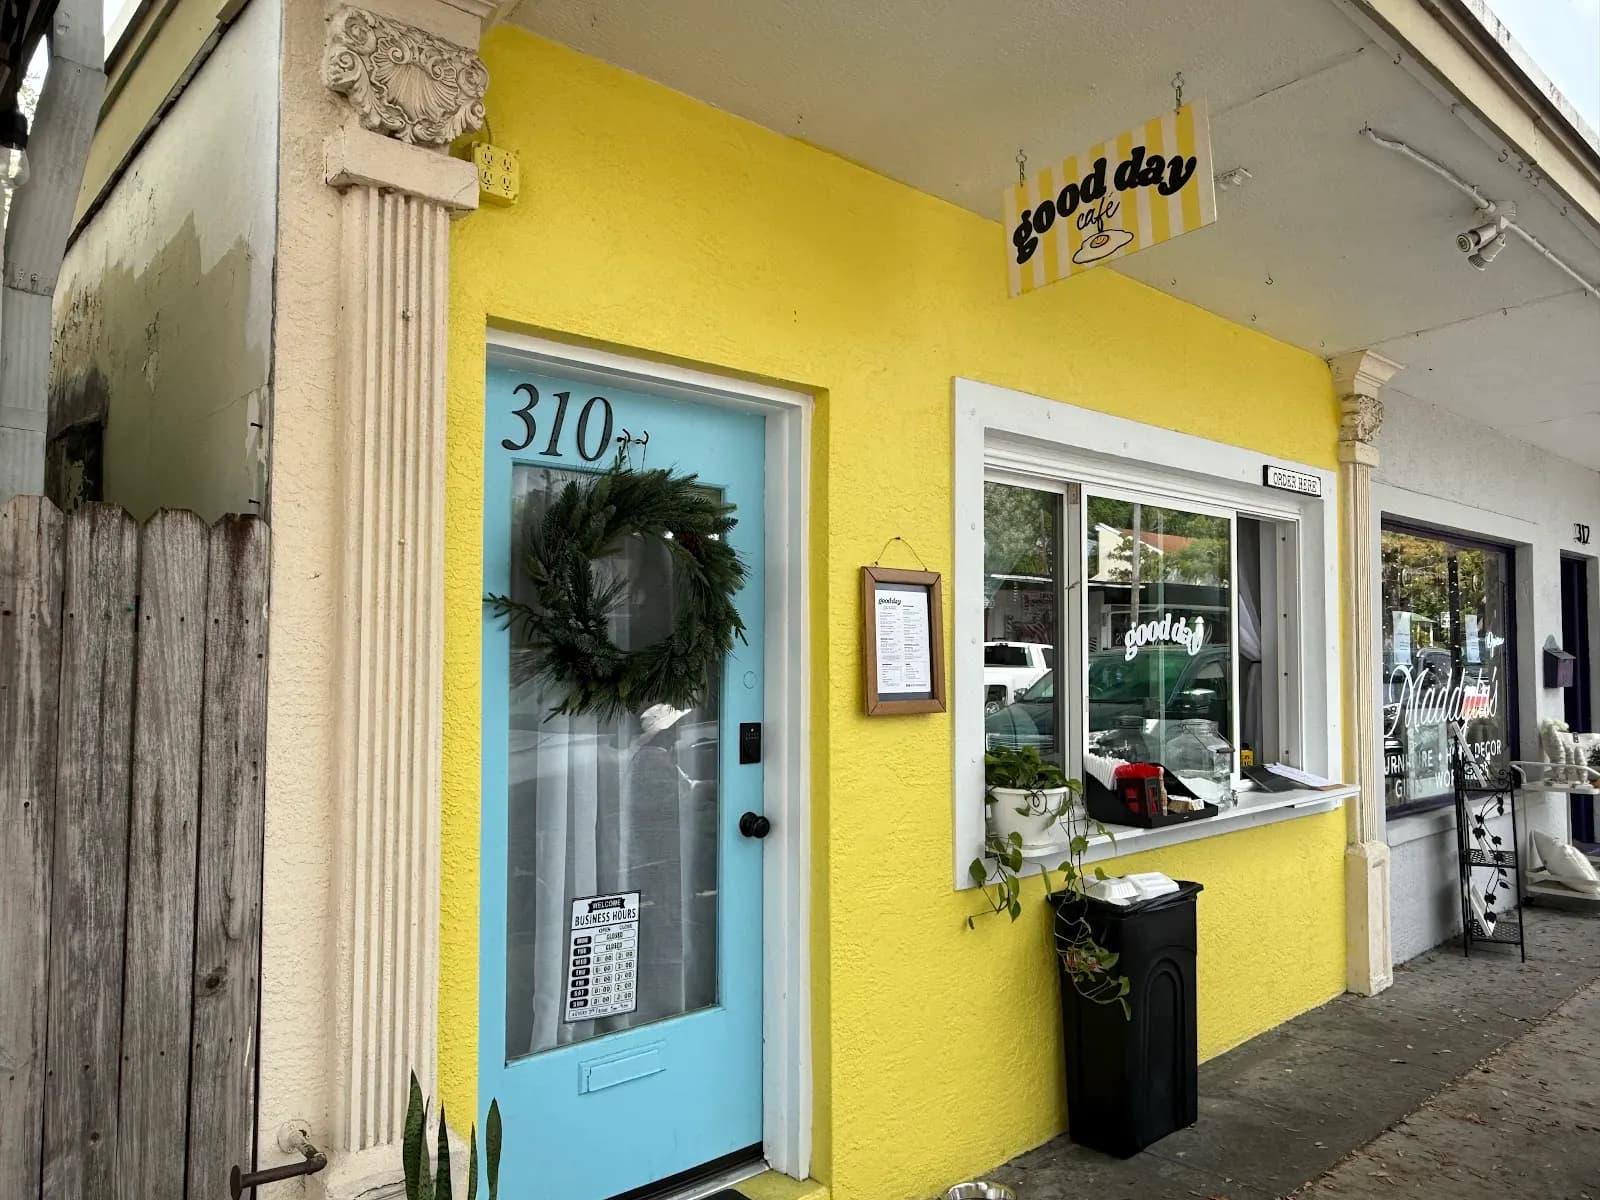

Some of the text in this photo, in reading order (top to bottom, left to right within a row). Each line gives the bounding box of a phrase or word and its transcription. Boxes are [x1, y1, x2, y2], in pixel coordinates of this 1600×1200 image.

[1012, 145, 1197, 265] good day
[500, 382, 615, 463] 310
[1273, 472, 1317, 493] ORDER HERE
[1124, 612, 1205, 662] good day
[1474, 739, 1502, 758] DECOR
[592, 898, 621, 910] WELCOME
[574, 908, 636, 927] BUSINESS HOURS
